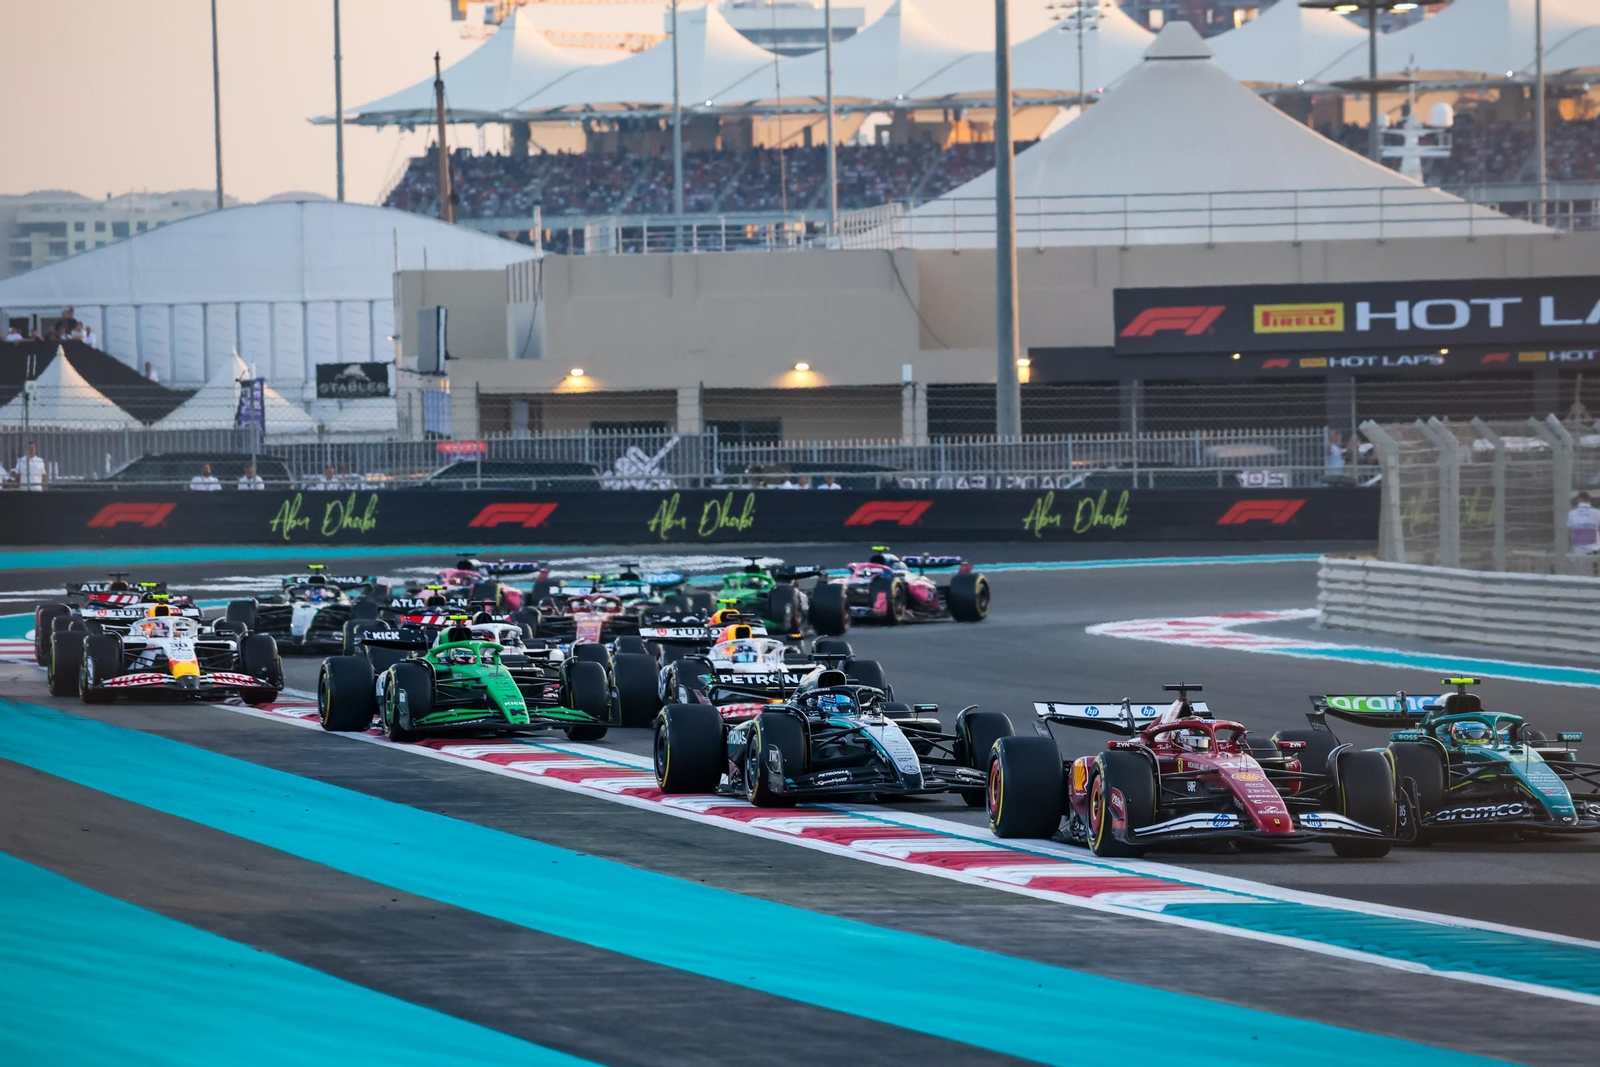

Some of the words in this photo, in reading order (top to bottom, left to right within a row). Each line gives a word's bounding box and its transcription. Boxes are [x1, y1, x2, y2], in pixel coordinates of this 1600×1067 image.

[1261, 308, 1336, 327] PIRELLI
[1356, 297, 1523, 331] HOT
[1540, 296, 1600, 326] L
[1329, 355, 1378, 367] HOT
[1382, 354, 1444, 366] LAPS
[1549, 350, 1598, 361] HOT
[269, 493, 310, 540] Abu
[322, 491, 379, 536] Dhabi
[648, 492, 686, 539] Abu
[698, 491, 756, 537] Dhabi
[1022, 491, 1061, 537] Abu
[1073, 490, 1130, 534] Dhabi
[373, 631, 400, 640] KICK
[110, 673, 163, 687] HUGO
[1085, 706, 1099, 717] hp
[1141, 706, 1156, 717] hp
[1436, 803, 1523, 821] aramco
